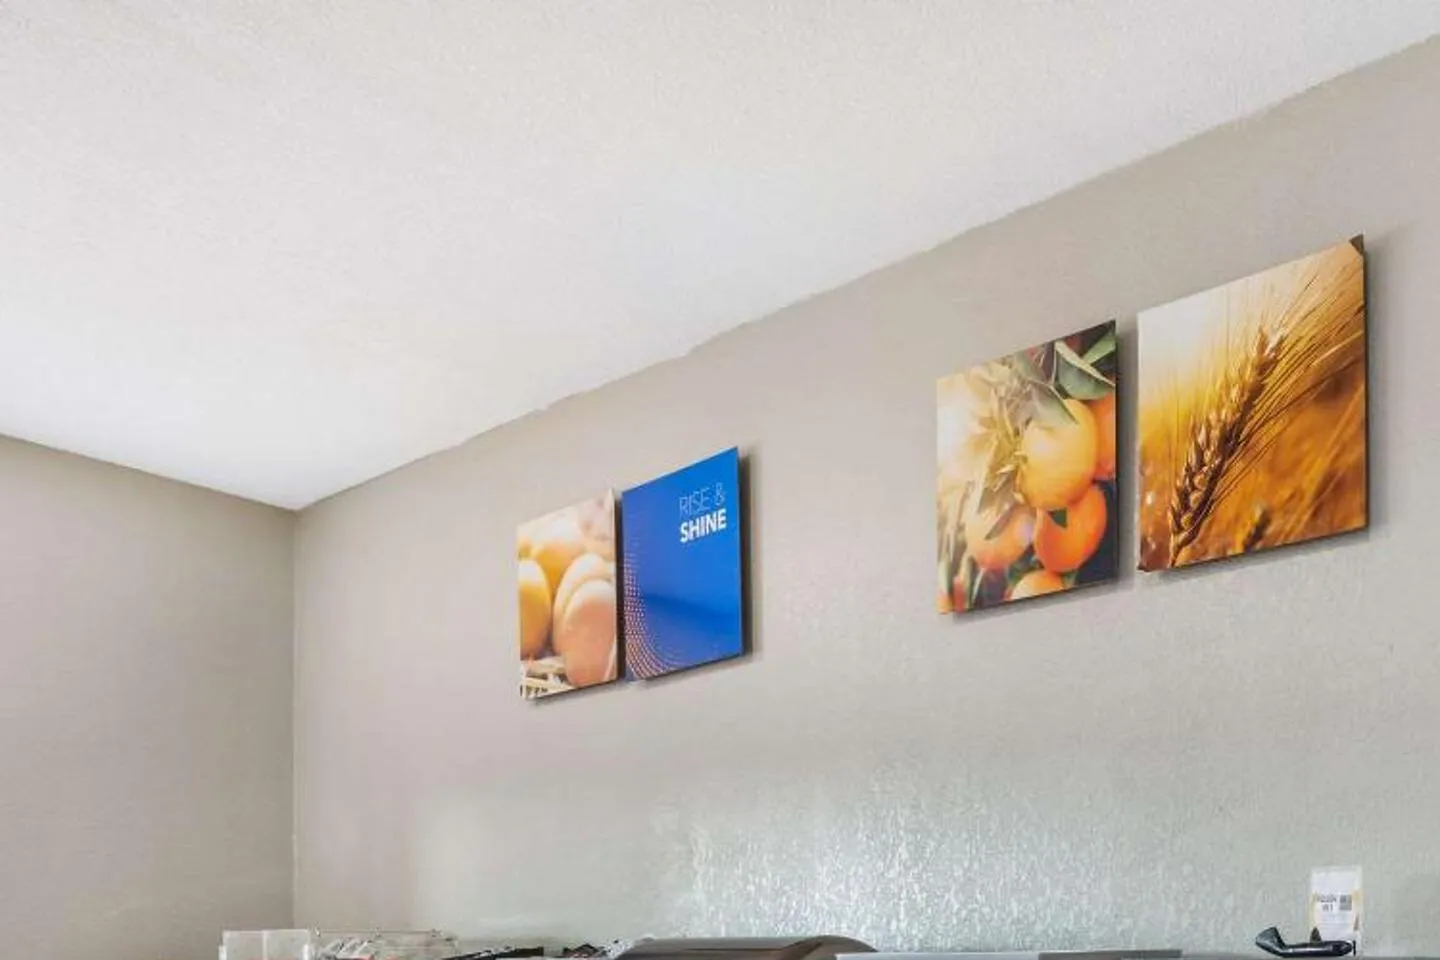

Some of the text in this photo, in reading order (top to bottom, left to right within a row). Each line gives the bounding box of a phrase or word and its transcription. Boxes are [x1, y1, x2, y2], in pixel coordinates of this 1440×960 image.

[679, 482, 726, 518] RISE &
[680, 508, 727, 543] SHINE
